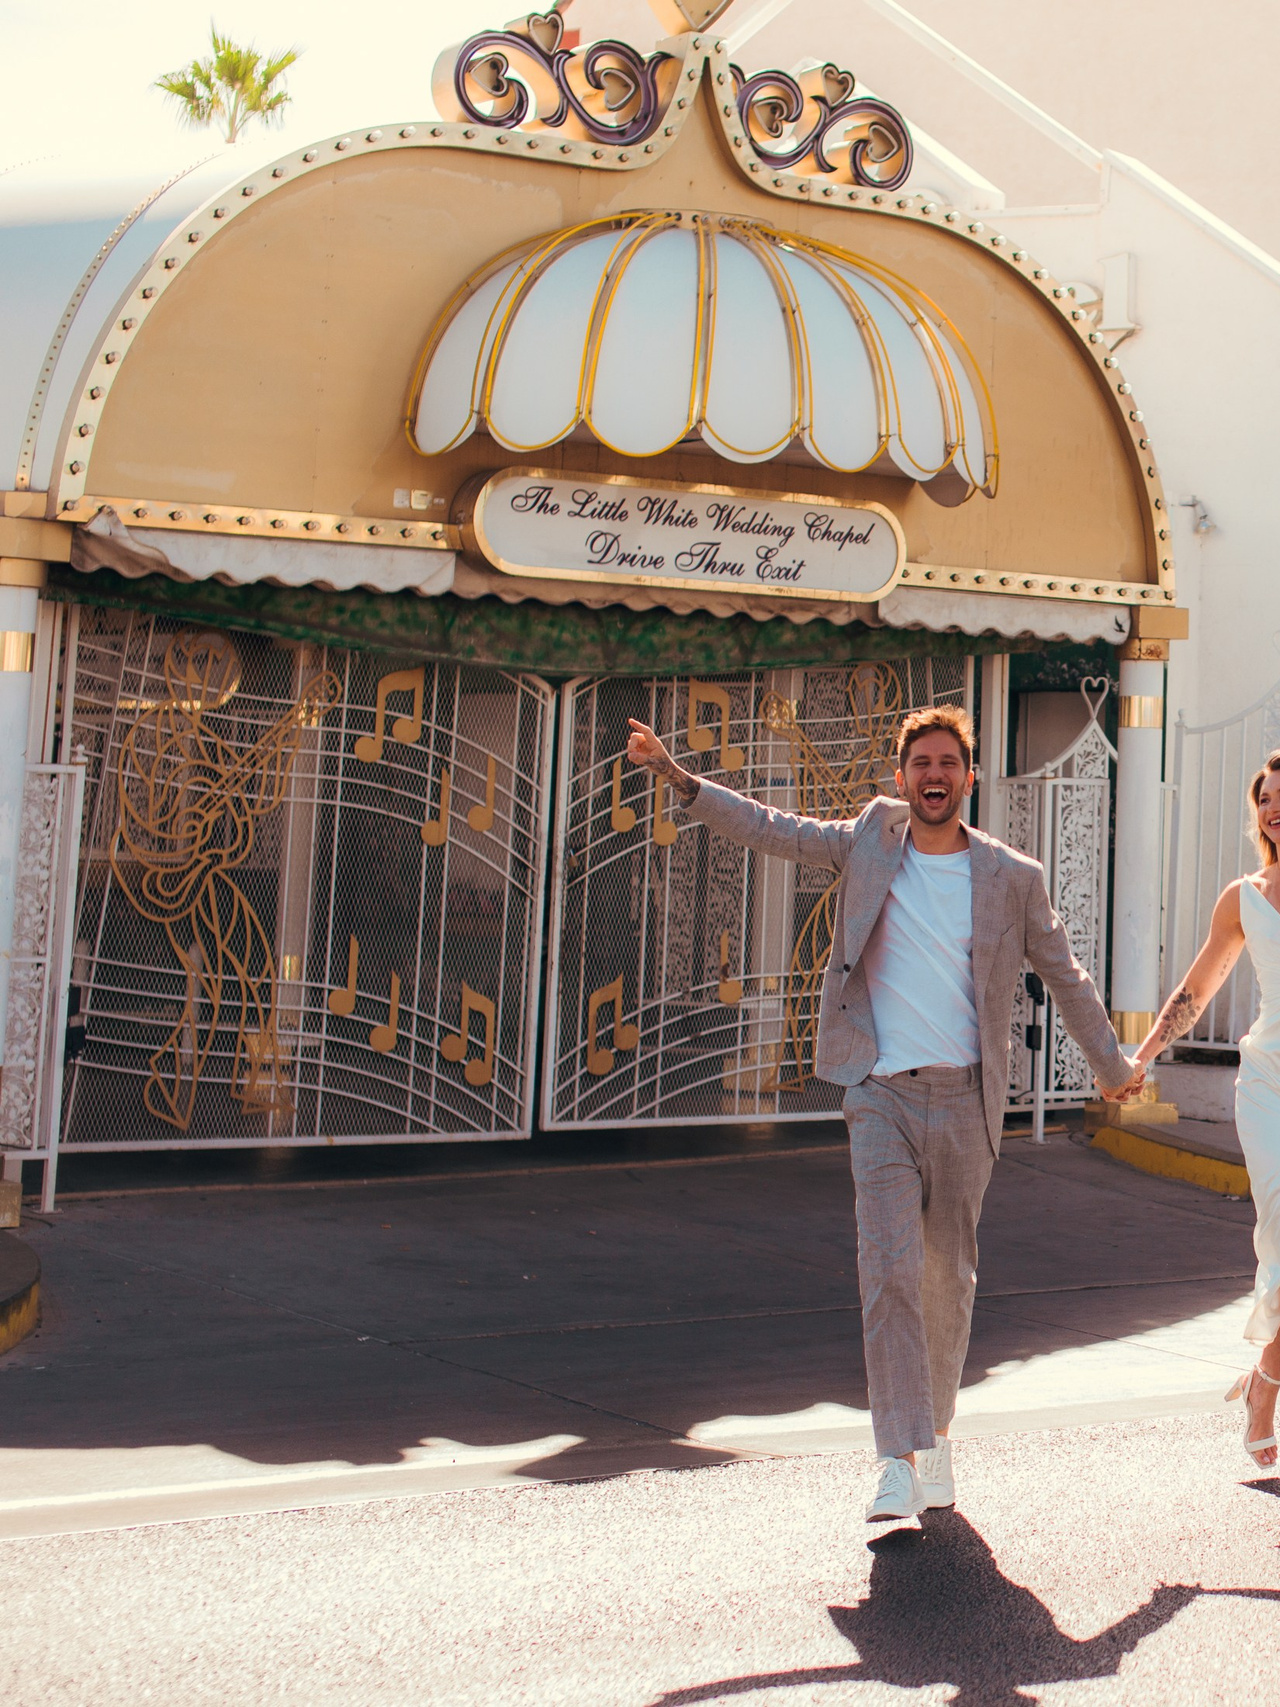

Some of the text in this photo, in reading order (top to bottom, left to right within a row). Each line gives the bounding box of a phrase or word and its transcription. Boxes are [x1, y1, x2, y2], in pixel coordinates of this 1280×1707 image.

[510, 485, 876, 551] The Little White Wedding Chapel
[585, 530, 806, 583] Drive Thru Exit
